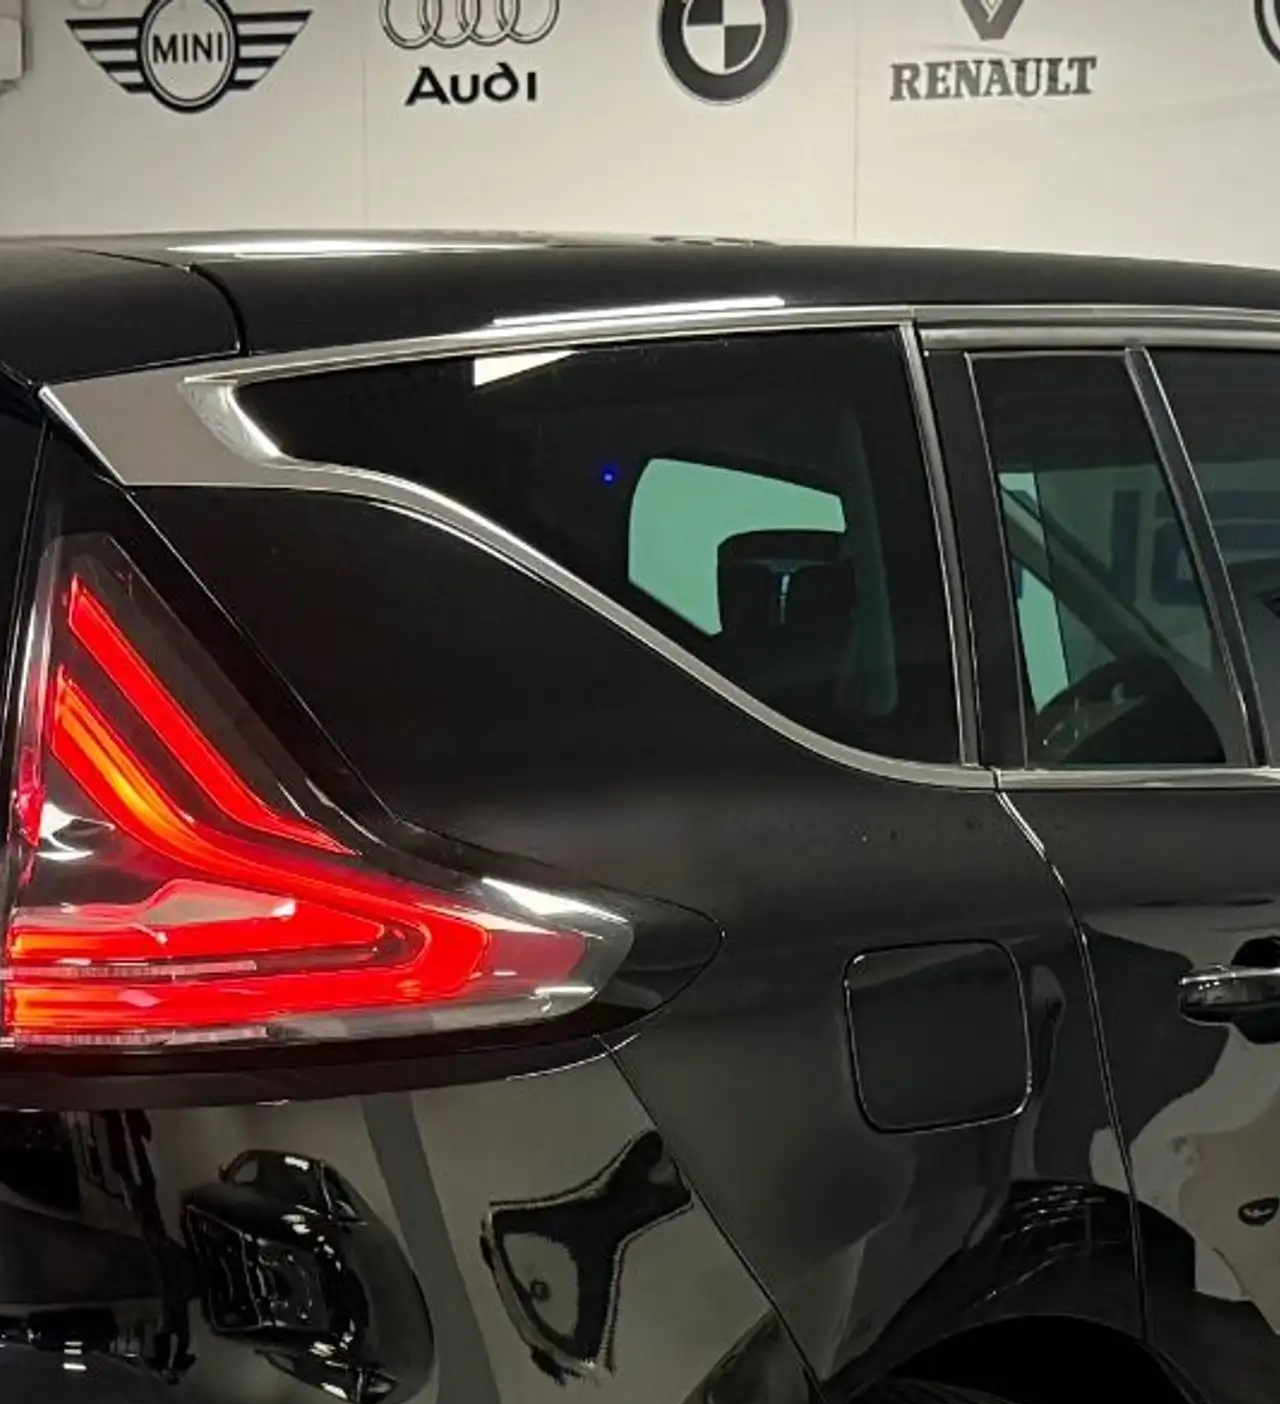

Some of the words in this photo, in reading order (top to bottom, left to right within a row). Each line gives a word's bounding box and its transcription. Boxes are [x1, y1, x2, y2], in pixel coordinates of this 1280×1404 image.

[152, 32, 223, 64] MINI
[405, 62, 538, 106] Audi
[890, 56, 1098, 101] RENAULT
